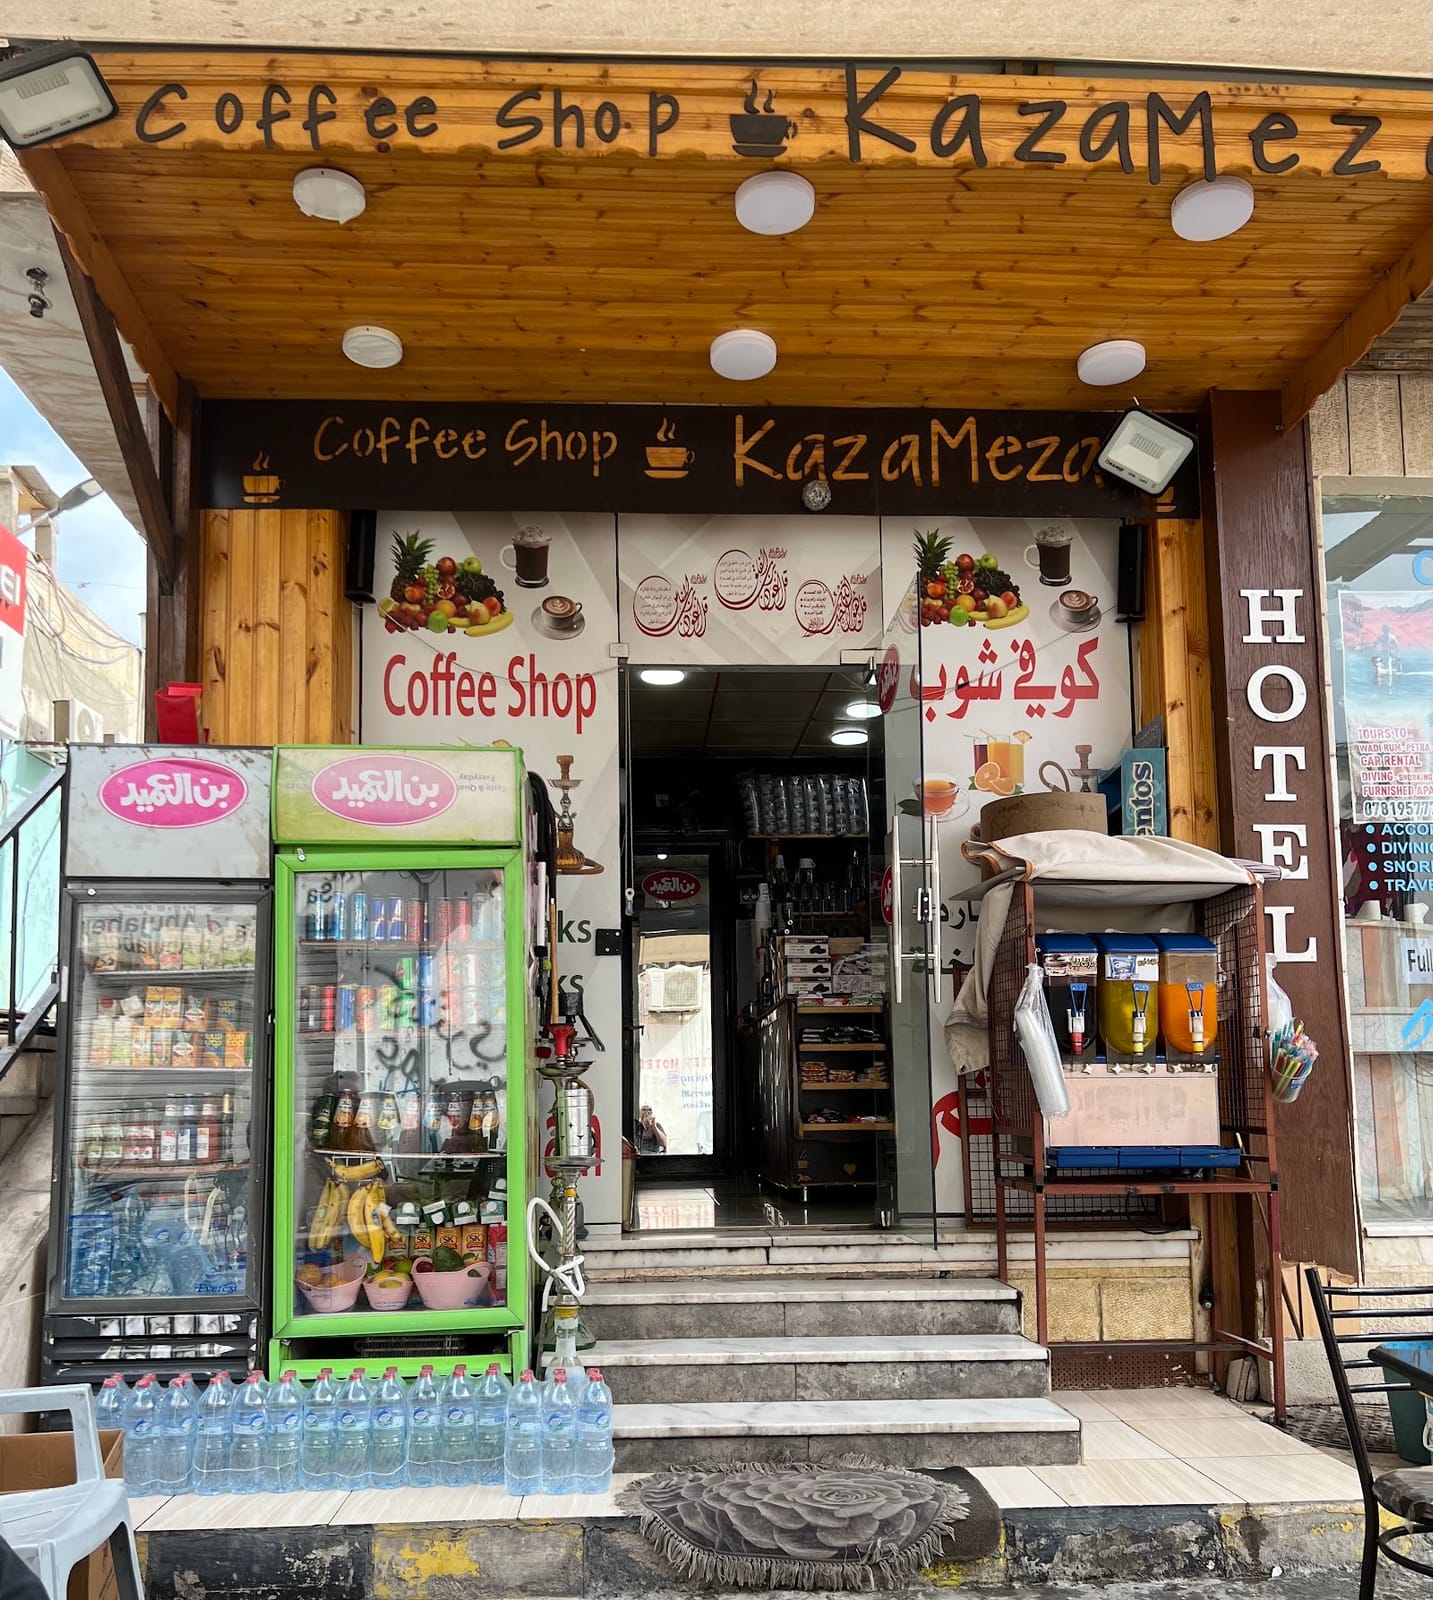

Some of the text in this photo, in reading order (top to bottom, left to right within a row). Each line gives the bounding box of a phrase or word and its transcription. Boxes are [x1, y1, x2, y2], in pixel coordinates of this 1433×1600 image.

[135, 62, 1433, 185] Coffee Shop KazaMez
[314, 415, 487, 465] Coffee
[504, 418, 618, 478] Shop
[384, 651, 597, 734] Coffee Shop
[909, 636, 1100, 721] كوفي شوب
[1359, 727, 1407, 740] TOURS TO
[1360, 744, 1382, 753] WADI
[1383, 743, 1401, 752] RUM
[1239, 588, 1318, 963] HOTEL
[1360, 754, 1422, 766] CAR RENTAL
[1361, 771, 1393, 782] DIVING
[119, 773, 231, 813] بن العميد
[332, 769, 404, 808] العميد
[403, 775, 440, 808] بن
[1129, 761, 1155, 837] ntos
[1362, 785, 1414, 797] FURNISHED
[557, 909, 592, 944] ks
